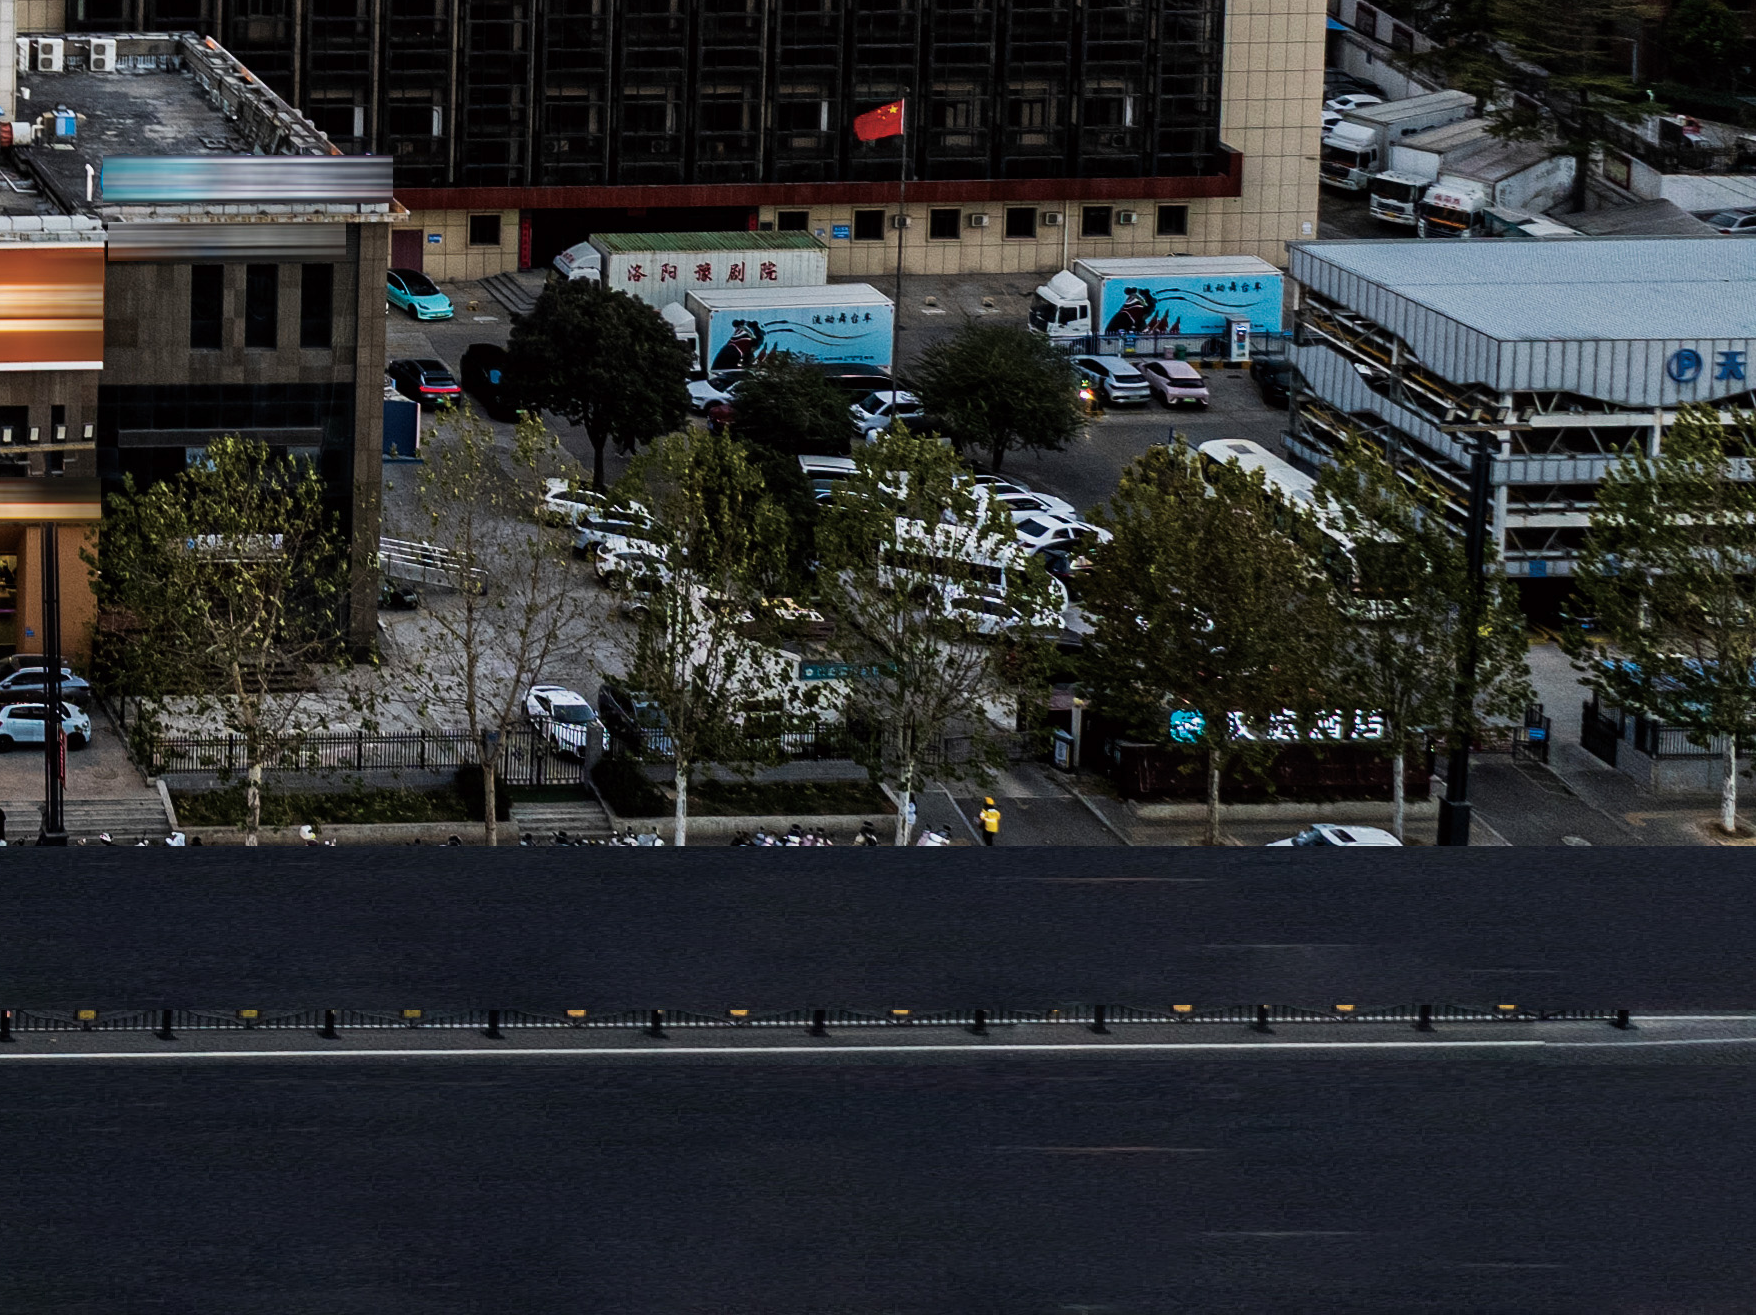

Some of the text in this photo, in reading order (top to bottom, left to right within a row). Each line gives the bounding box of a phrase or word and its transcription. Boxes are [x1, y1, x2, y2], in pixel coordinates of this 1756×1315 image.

[627, 260, 779, 283] 洛阳豫剧院
[1203, 281, 1263, 293] 流动舞台车
[812, 312, 872, 325] 流动舞台车
[1715, 351, 1747, 380] 天
